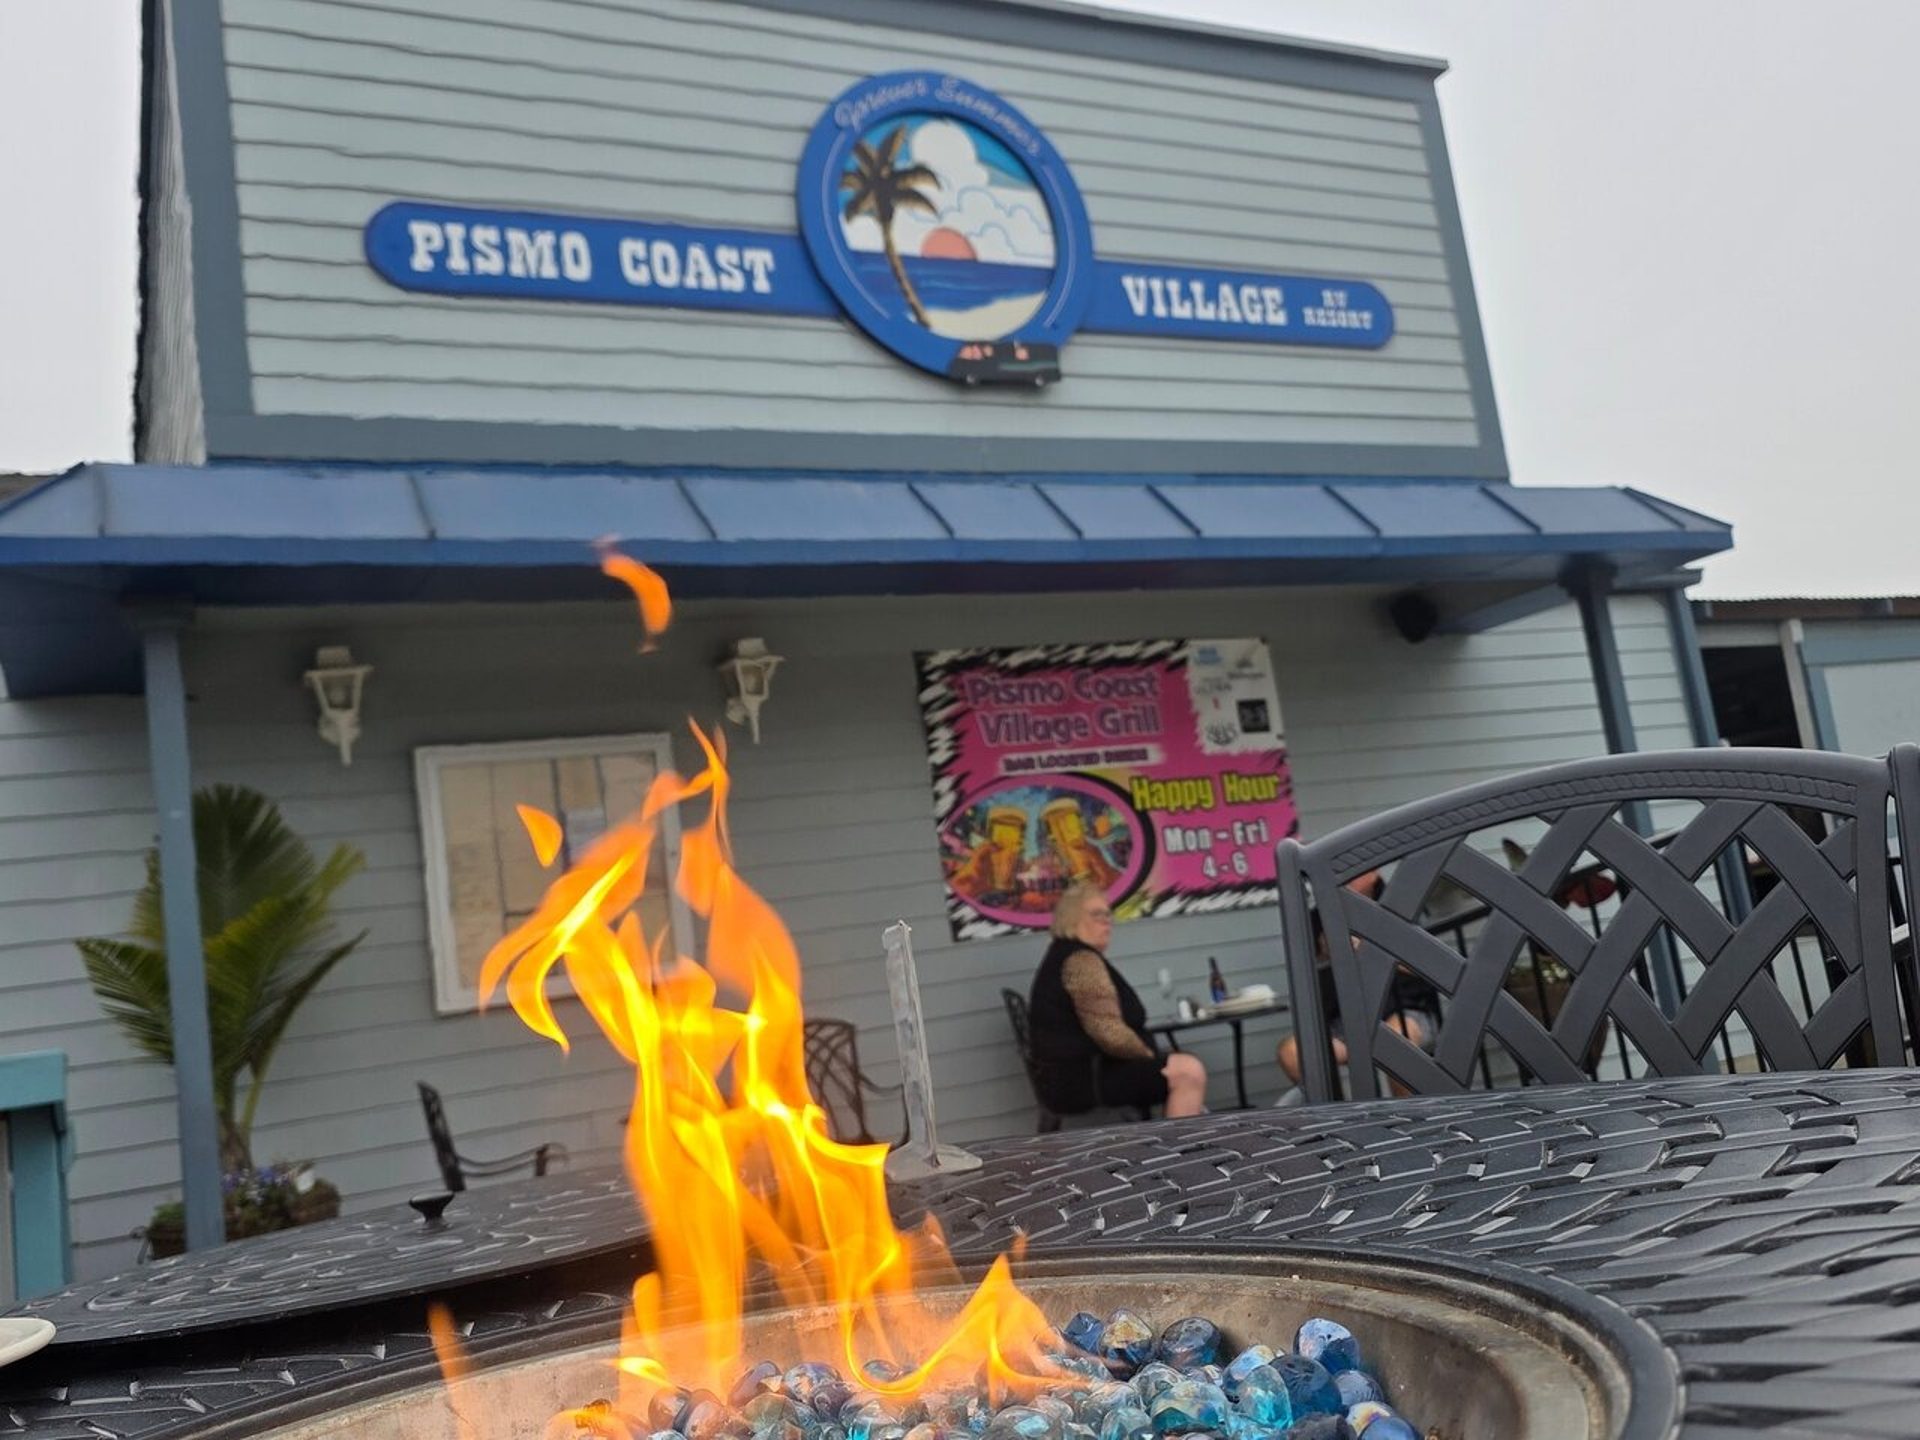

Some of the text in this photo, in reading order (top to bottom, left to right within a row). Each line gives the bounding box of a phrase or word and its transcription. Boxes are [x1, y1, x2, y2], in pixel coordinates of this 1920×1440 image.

[408, 219, 1288, 327] PISMO COAST VILLAGE
[1302, 306, 1374, 331] RESORT
[963, 672, 1065, 705] Pismo
[1072, 669, 1160, 700] Coast
[979, 704, 1162, 746] Village Grill
[1130, 773, 1280, 812] Happy Hour
[1164, 827, 1213, 853] Mon
[1232, 818, 1269, 846] Fri
[1202, 855, 1218, 878] 4
[1231, 851, 1249, 877] 6
